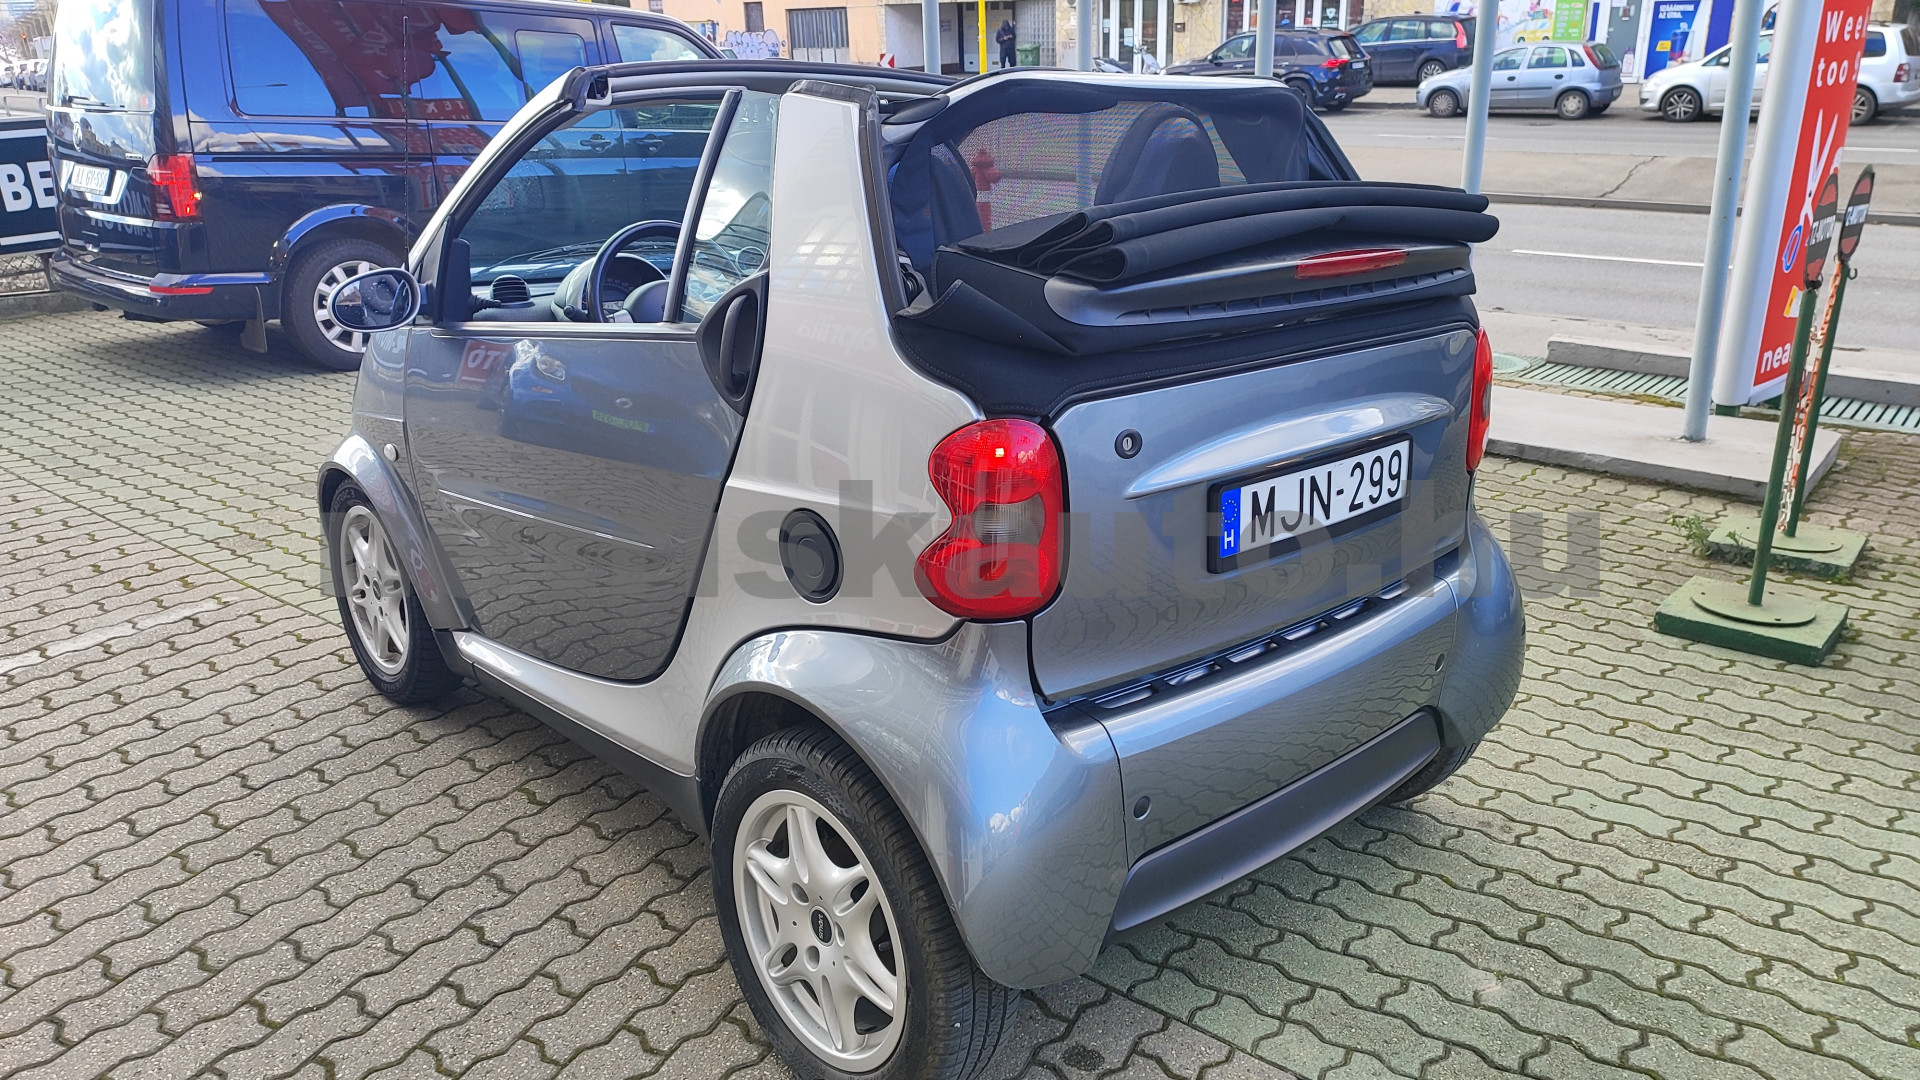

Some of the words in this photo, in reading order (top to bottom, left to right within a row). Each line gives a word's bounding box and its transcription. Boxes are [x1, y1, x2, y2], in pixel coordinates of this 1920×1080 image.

[1816, 58, 1848, 88] too
[1760, 342, 1791, 374] nea
[1251, 449, 1402, 544] MJN-299
[1223, 529, 1235, 550] H
